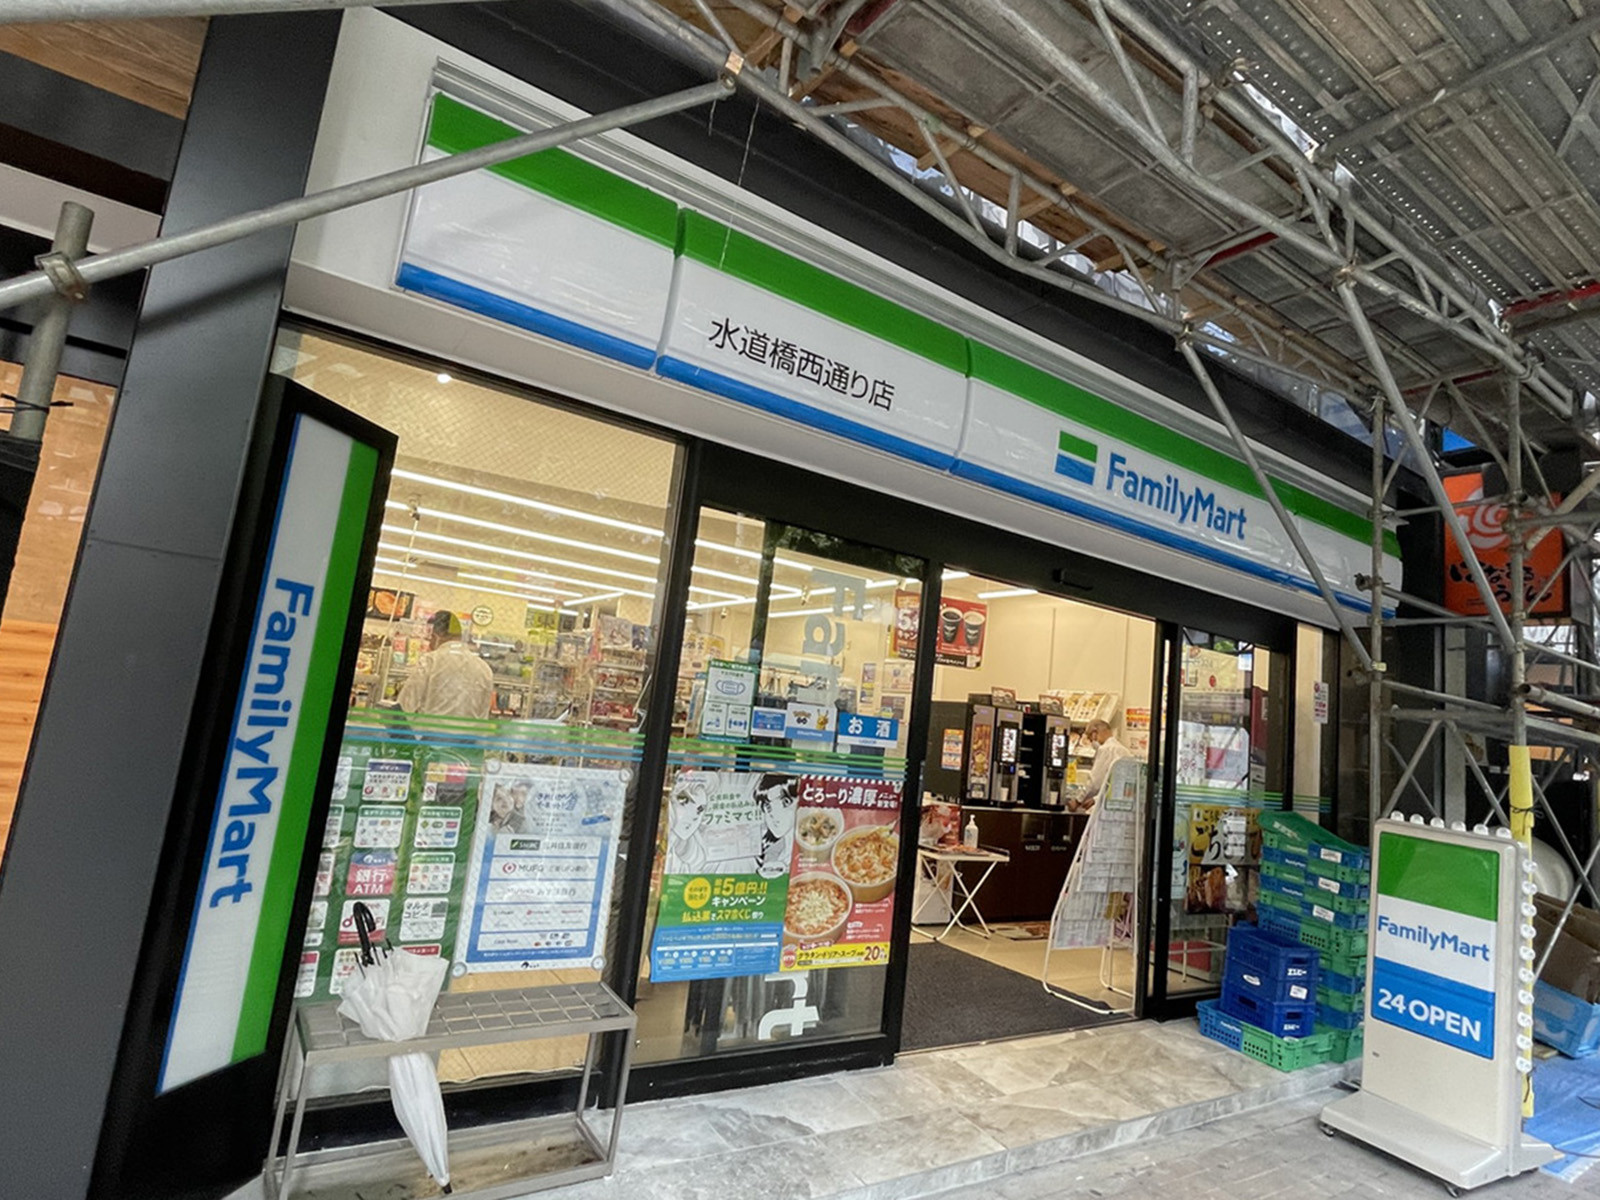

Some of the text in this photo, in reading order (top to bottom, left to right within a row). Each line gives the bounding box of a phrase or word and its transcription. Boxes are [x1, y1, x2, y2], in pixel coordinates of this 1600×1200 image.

[708, 316, 896, 412] 水道橋西通り店
[1106, 452, 1248, 541] FamilyMart
[847, 716, 892, 739] お酒
[209, 577, 316, 909] FamilyMart
[802, 782, 878, 807] とろーり濃厚
[355, 868, 390, 883] 銀行
[353, 883, 384, 894] ATM
[712, 896, 766, 907] キャンペーン
[1377, 915, 1491, 962] FamilyMart
